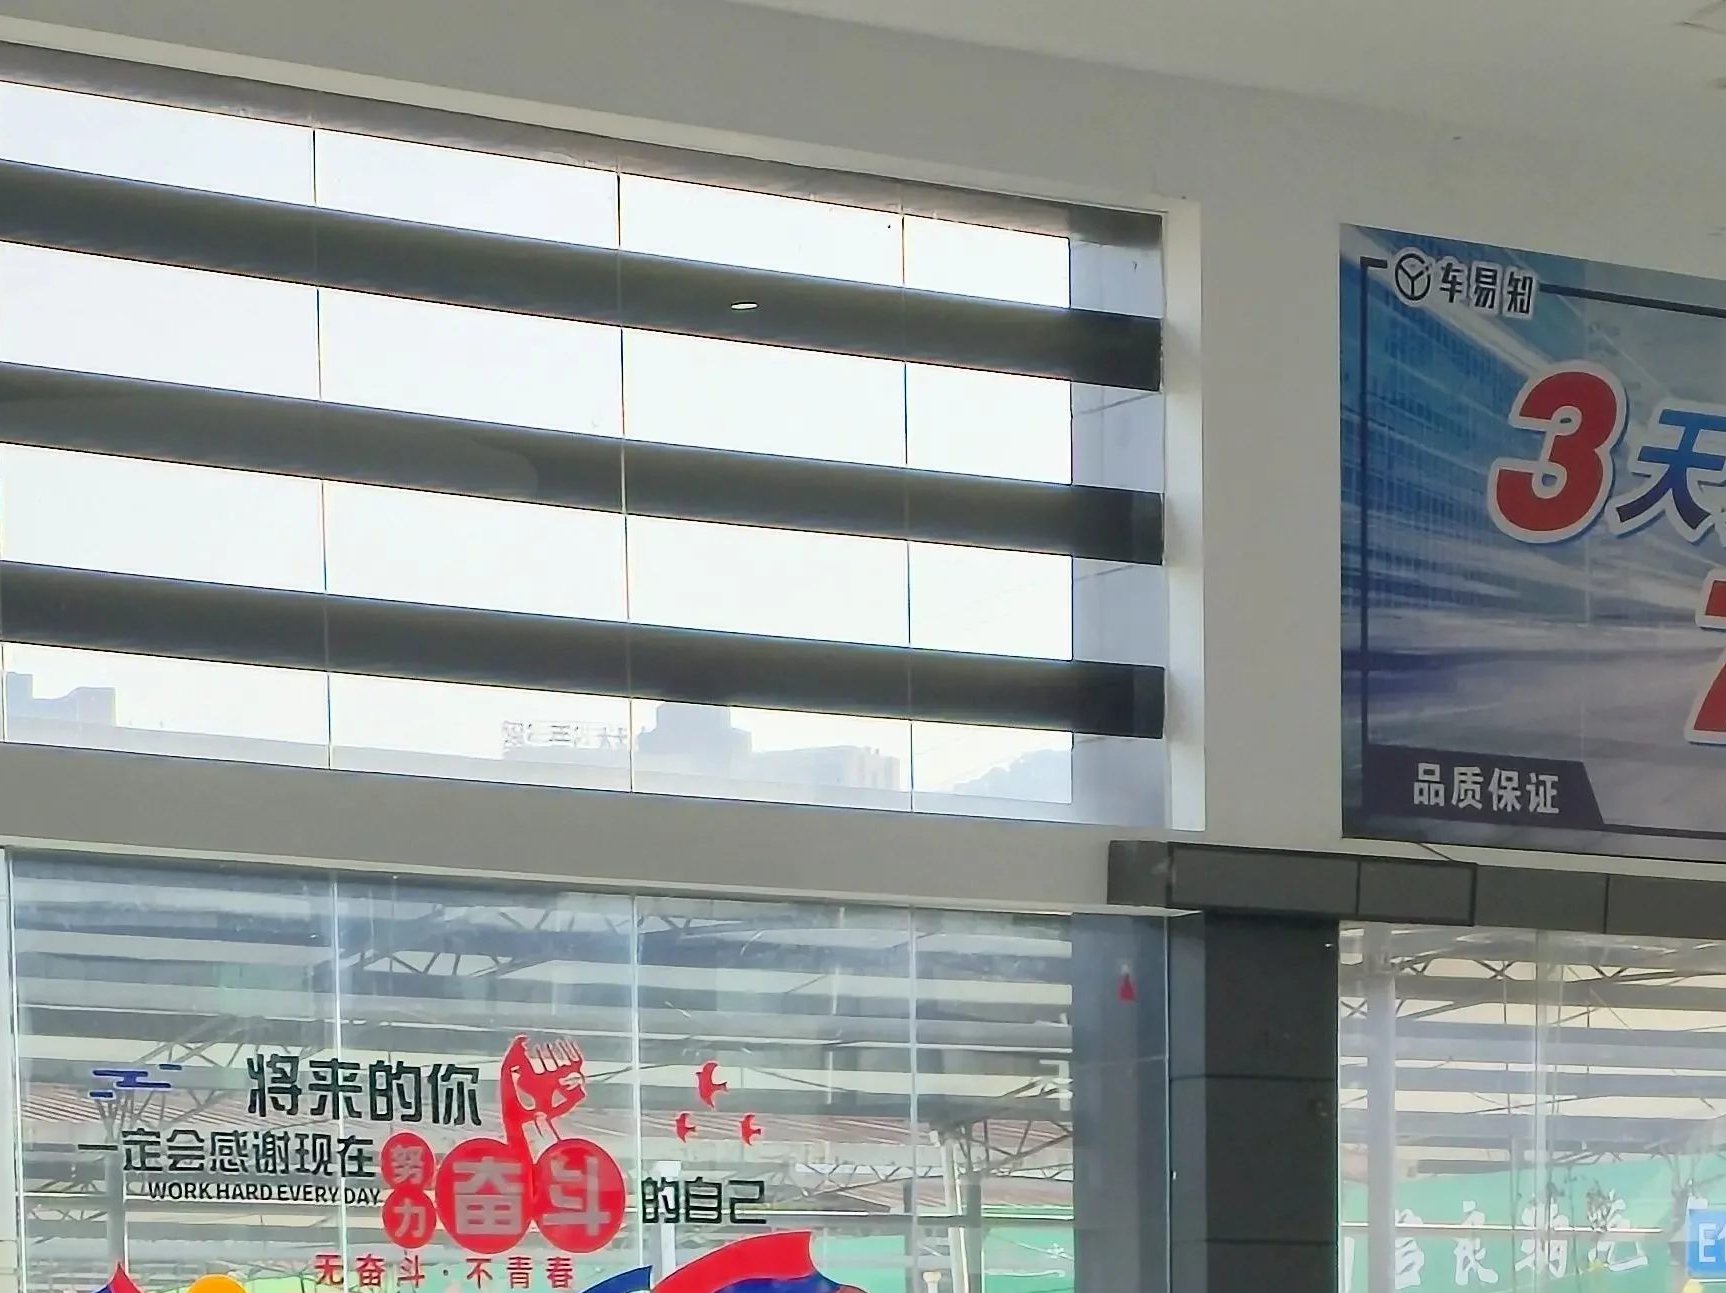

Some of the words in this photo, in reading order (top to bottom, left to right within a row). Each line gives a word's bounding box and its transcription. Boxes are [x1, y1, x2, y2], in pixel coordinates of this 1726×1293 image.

[1440, 263, 1532, 314] 车易知
[1413, 763, 1560, 815] 品质保证
[247, 1053, 482, 1128] 将来的你
[77, 1127, 376, 1178] 一定会感谢现在
[452, 1155, 612, 1237] 奋斗
[641, 1176, 768, 1225] 的自己
[148, 1181, 214, 1200] WORK
[216, 1183, 273, 1200] HARD
[277, 1184, 338, 1202] EVERY
[344, 1187, 381, 1206] DAY
